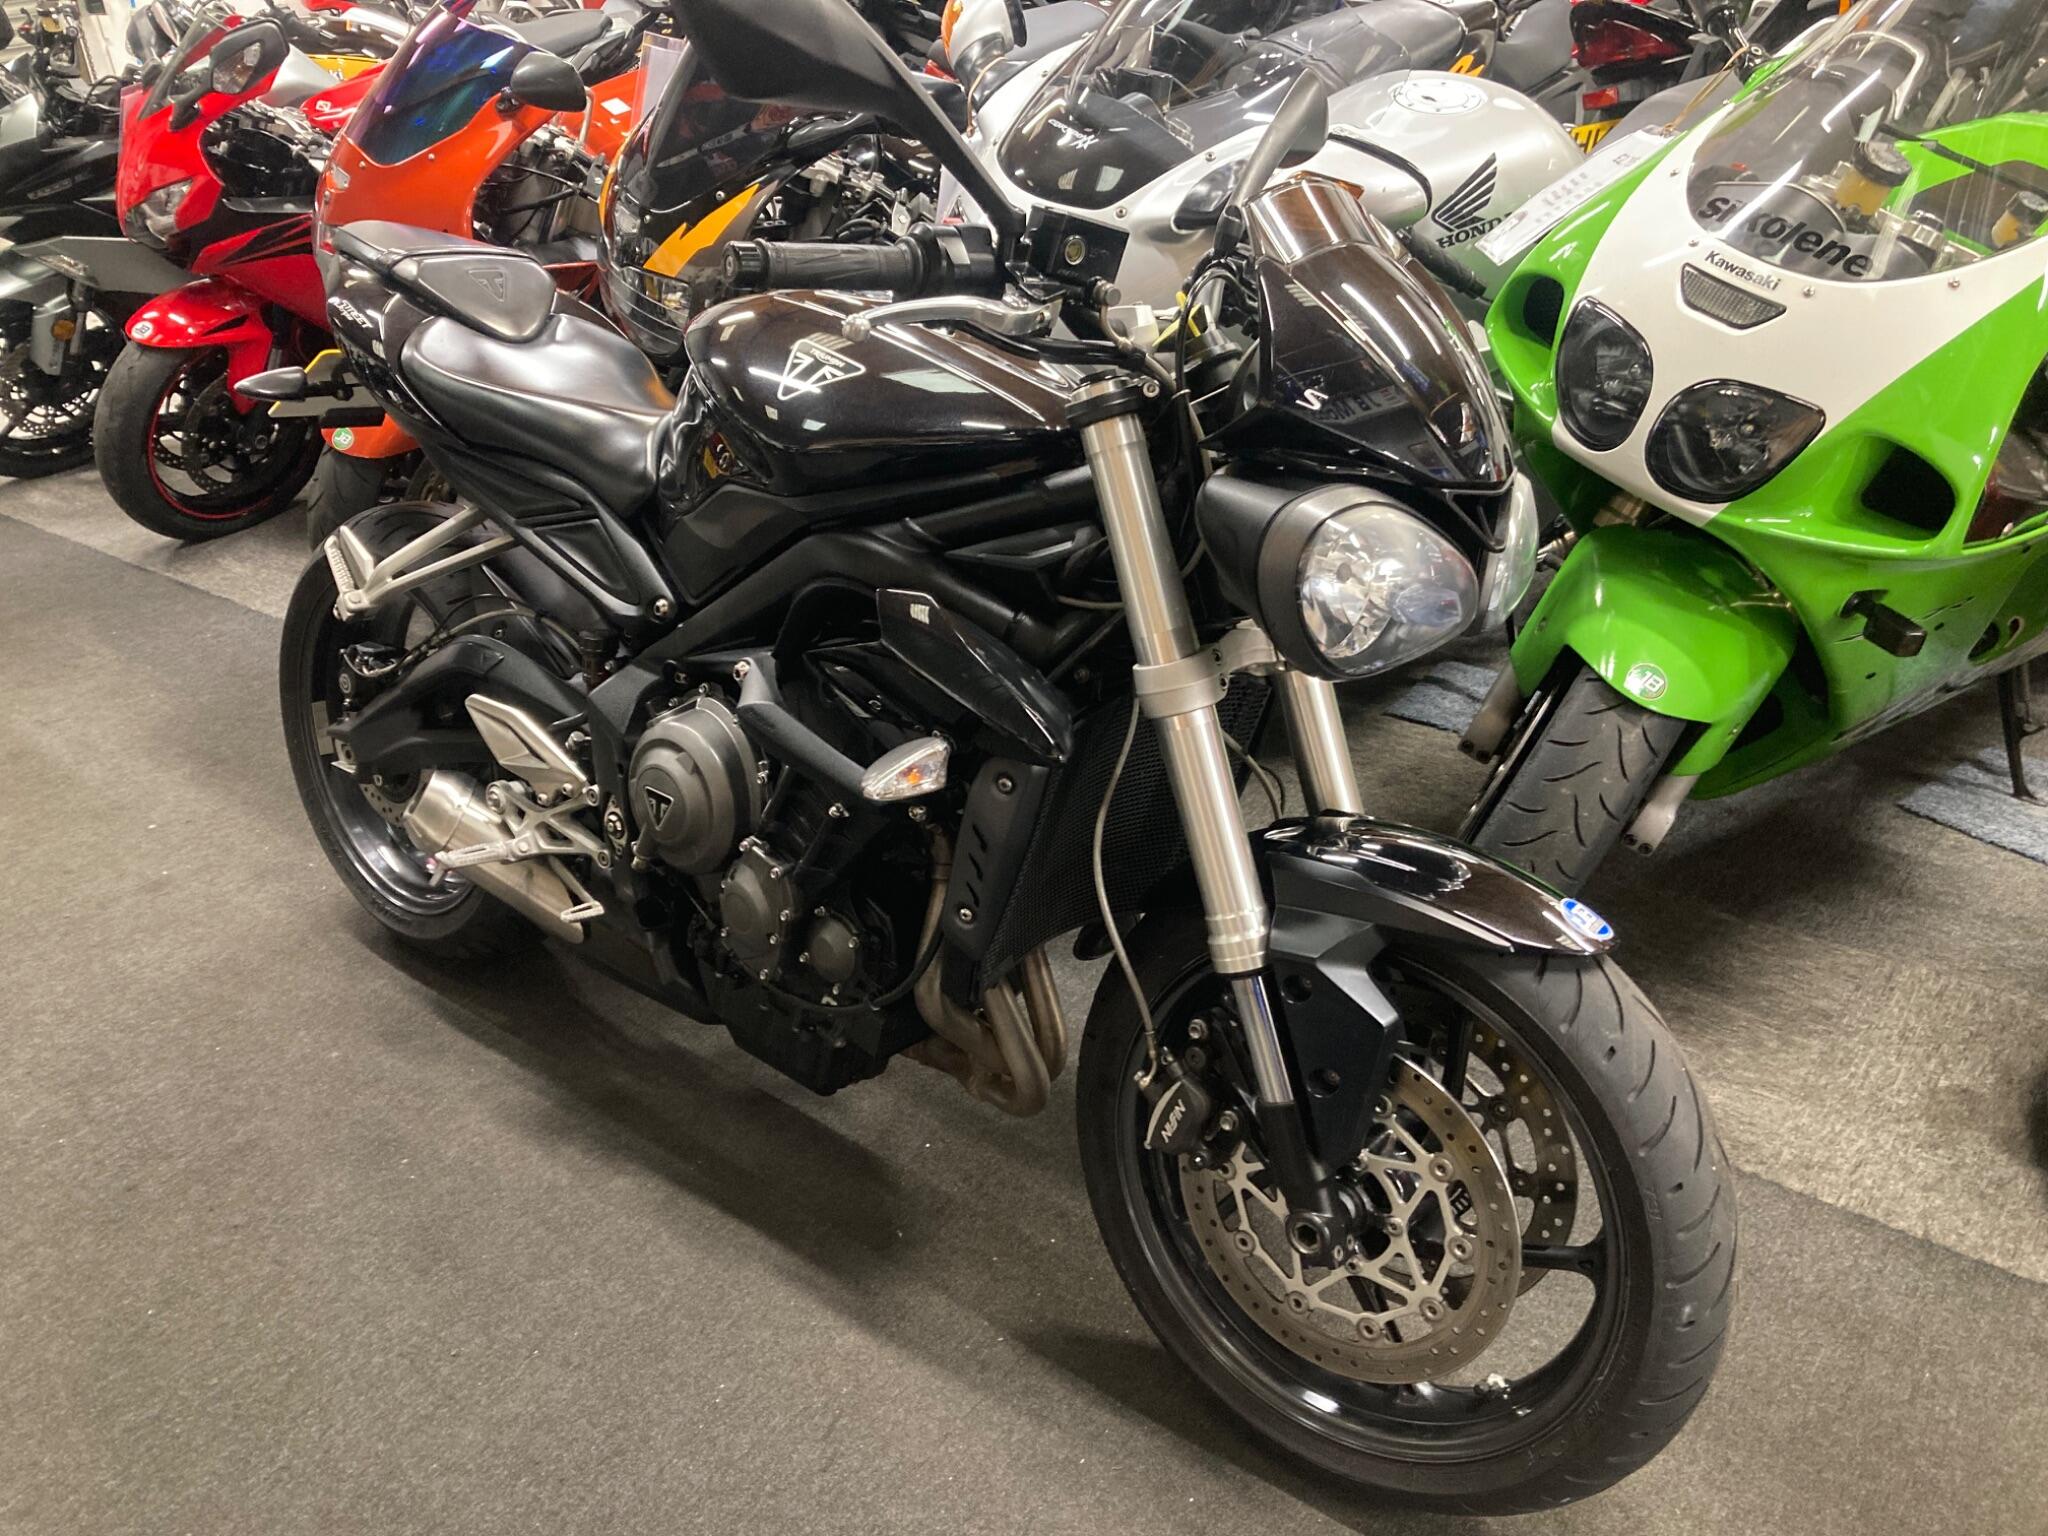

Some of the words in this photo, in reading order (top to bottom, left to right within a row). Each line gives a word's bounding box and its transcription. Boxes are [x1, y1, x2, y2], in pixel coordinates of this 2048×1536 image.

[1436, 212, 1512, 249] HOND
[1697, 197, 1873, 278] sikolene
[1704, 250, 1782, 291] Kawasaki
[809, 347, 846, 368] TRIUMPH
